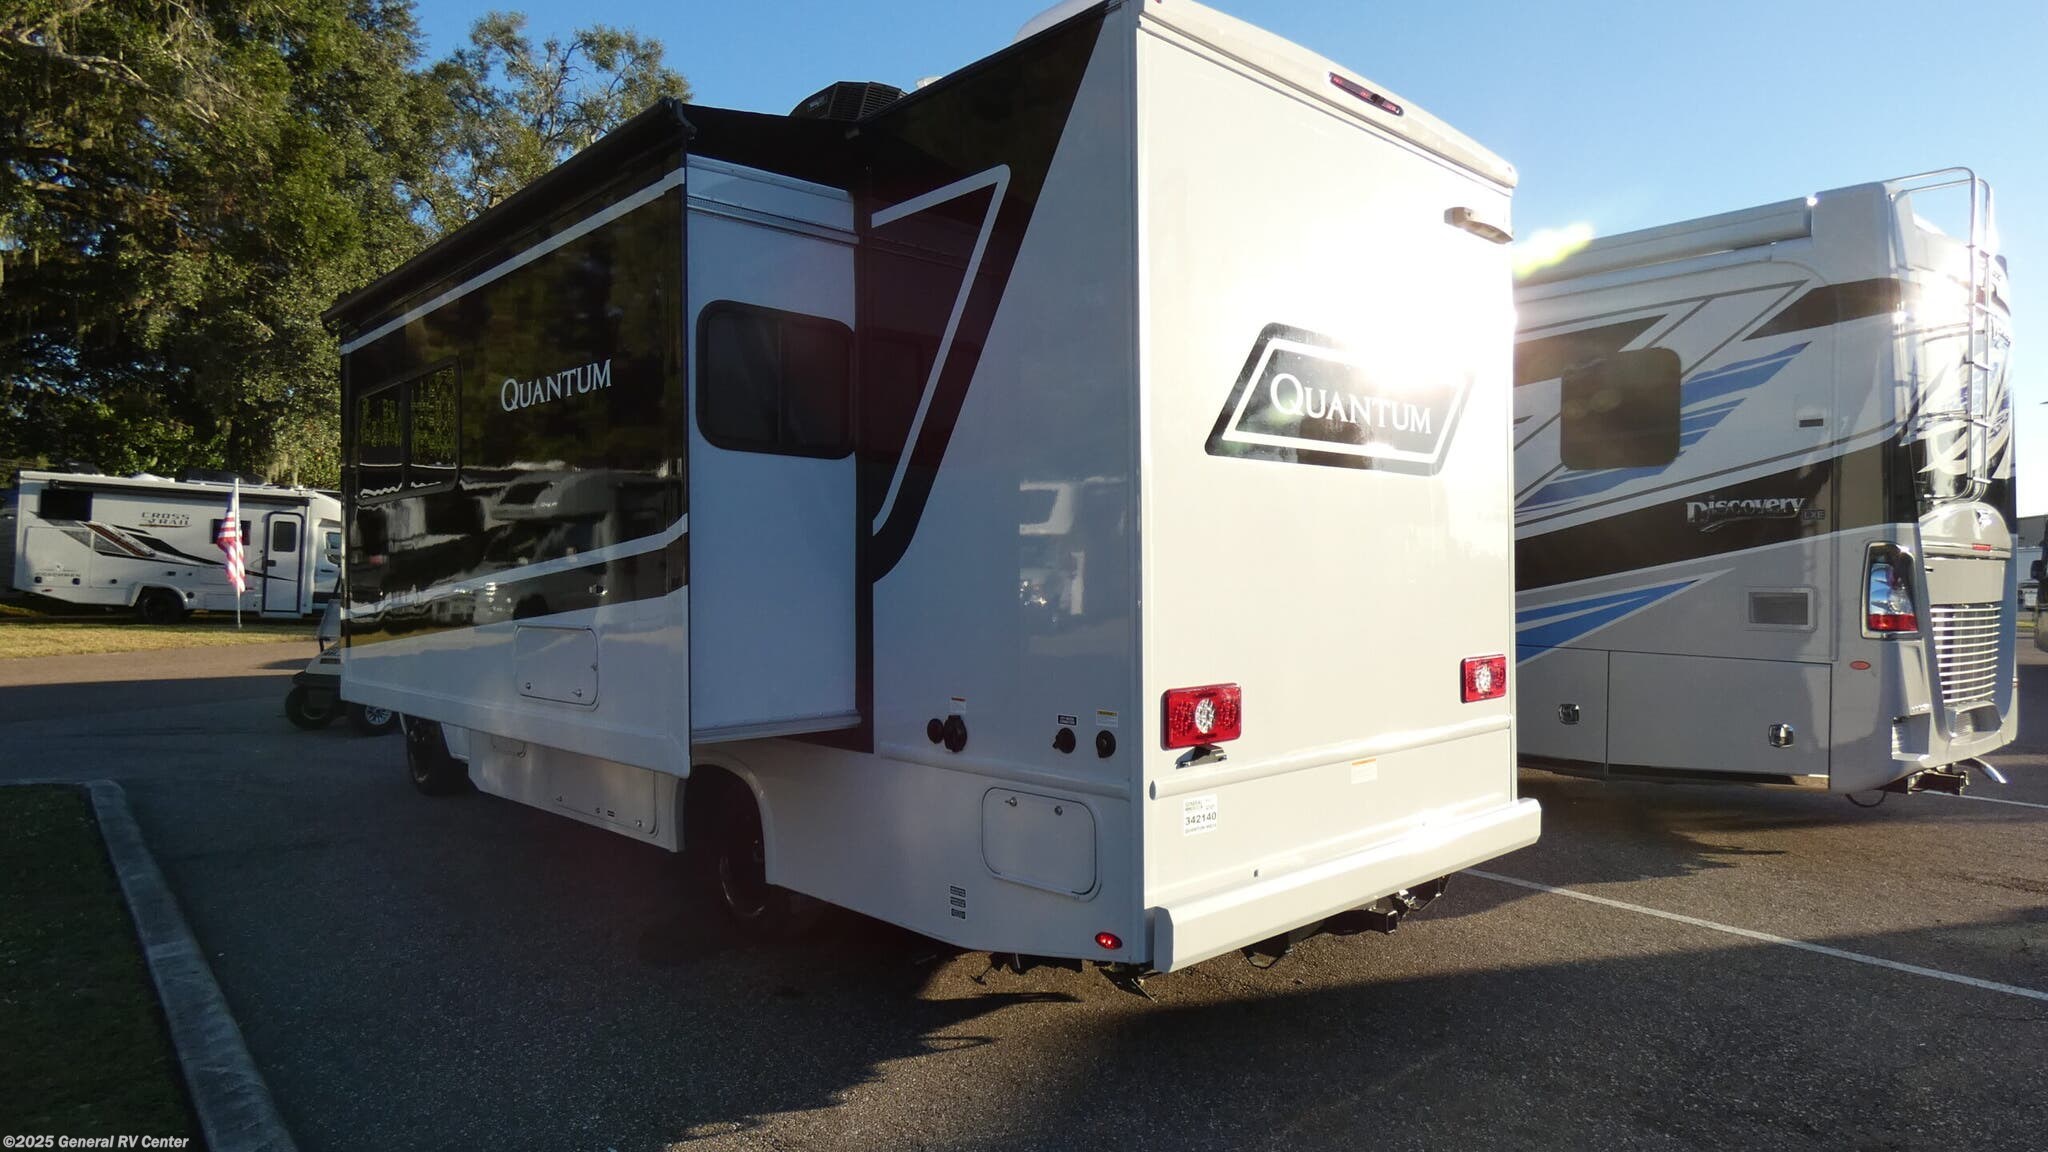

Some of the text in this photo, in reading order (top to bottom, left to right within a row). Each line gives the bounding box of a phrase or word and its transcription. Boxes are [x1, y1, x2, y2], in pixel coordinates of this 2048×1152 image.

[500, 358, 612, 412] QUANTUM
[1269, 372, 1432, 435] QUANTUM
[141, 511, 190, 520] CROSS
[1686, 495, 1806, 523] Discovery
[1185, 811, 1217, 826] 342140
